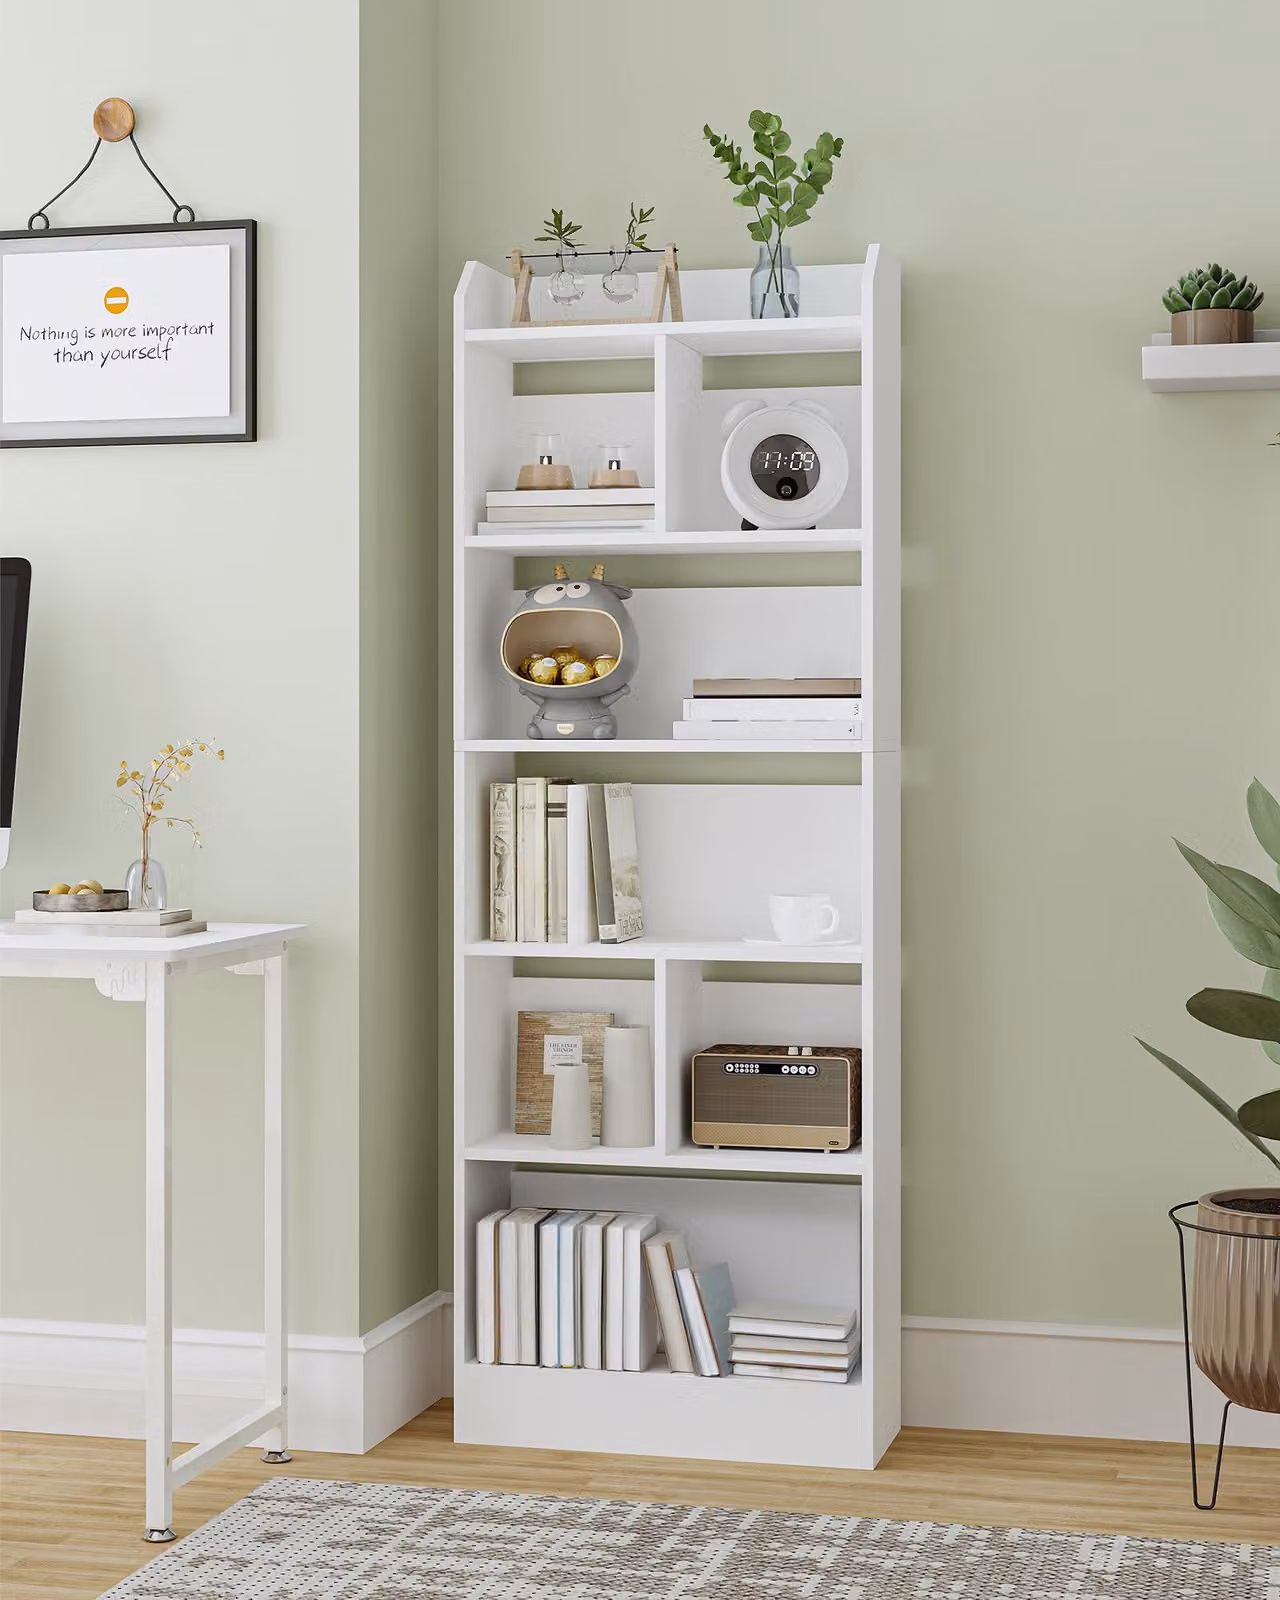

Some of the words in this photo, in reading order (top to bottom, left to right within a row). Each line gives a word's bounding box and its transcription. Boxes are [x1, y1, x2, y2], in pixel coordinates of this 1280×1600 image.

[19, 325, 79, 346] Nothing
[84, 325, 96, 339] is
[101, 327, 137, 339] more
[142, 321, 215, 341] important
[53, 346, 94, 364] than
[100, 337, 174, 368] yourself
